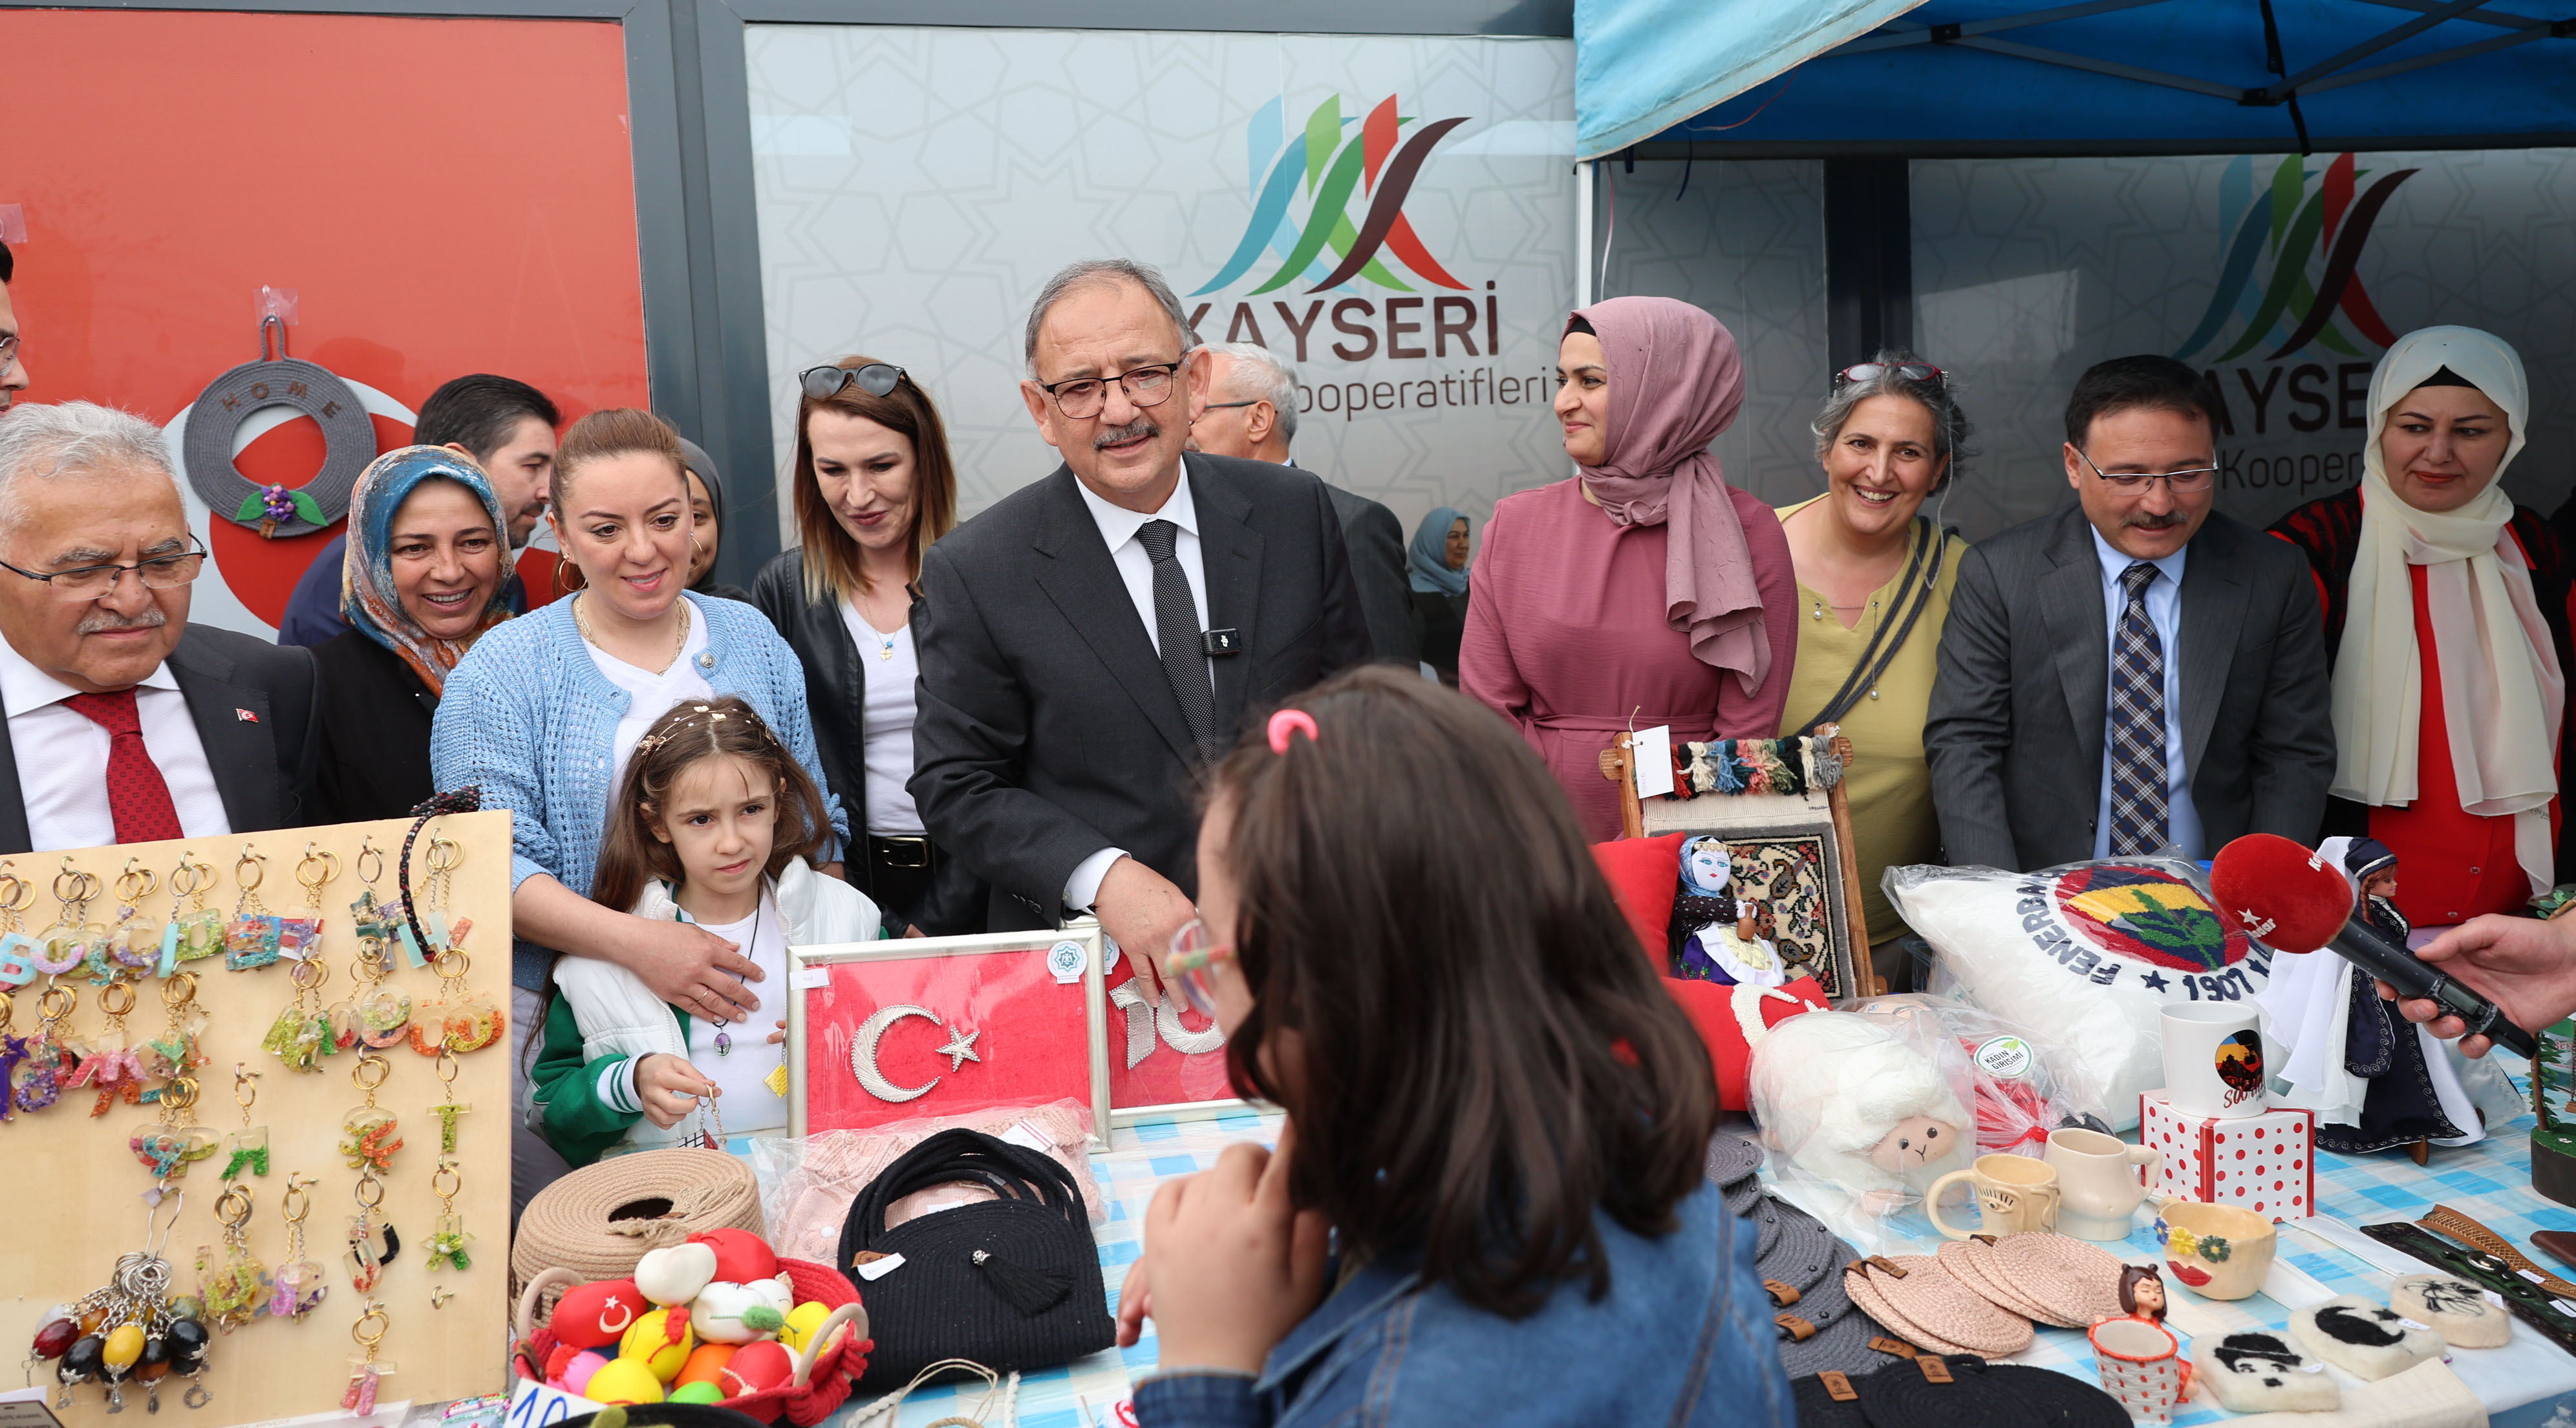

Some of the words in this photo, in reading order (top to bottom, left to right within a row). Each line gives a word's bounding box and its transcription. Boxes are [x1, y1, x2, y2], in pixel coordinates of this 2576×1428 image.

[220, 380, 341, 419] HOME
[1299, 365, 1547, 422] ooperatifleri
[2222, 448, 2361, 496] Kooper
[2182, 967, 2255, 1001] 1907
[1984, 1049, 2010, 1065] KADIN
